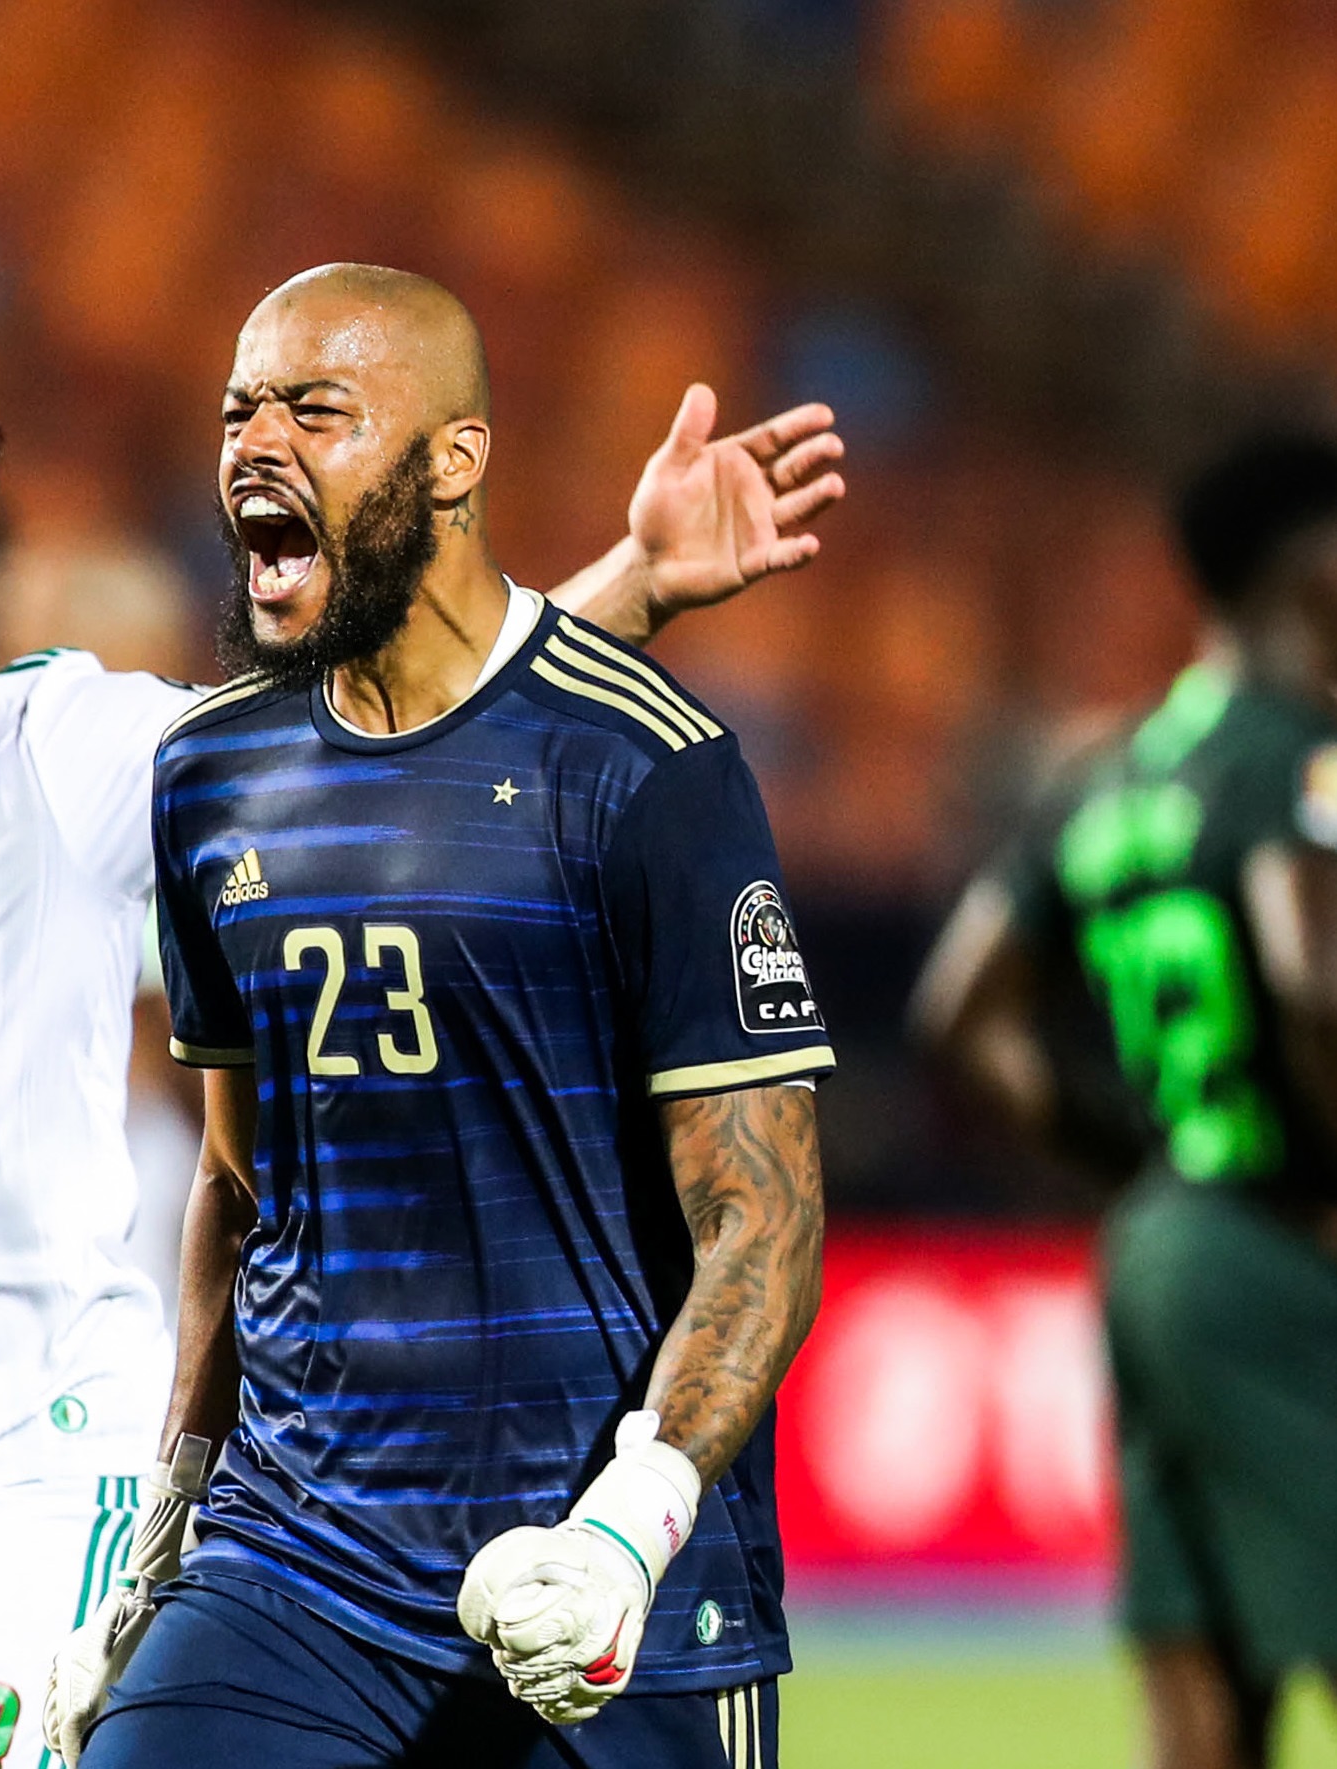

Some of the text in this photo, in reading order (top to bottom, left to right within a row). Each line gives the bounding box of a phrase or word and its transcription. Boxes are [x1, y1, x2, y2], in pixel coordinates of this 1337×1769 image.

[222, 881, 269, 906] adidas
[283, 925, 440, 1076] 23
[759, 1000, 817, 1019] CAF
